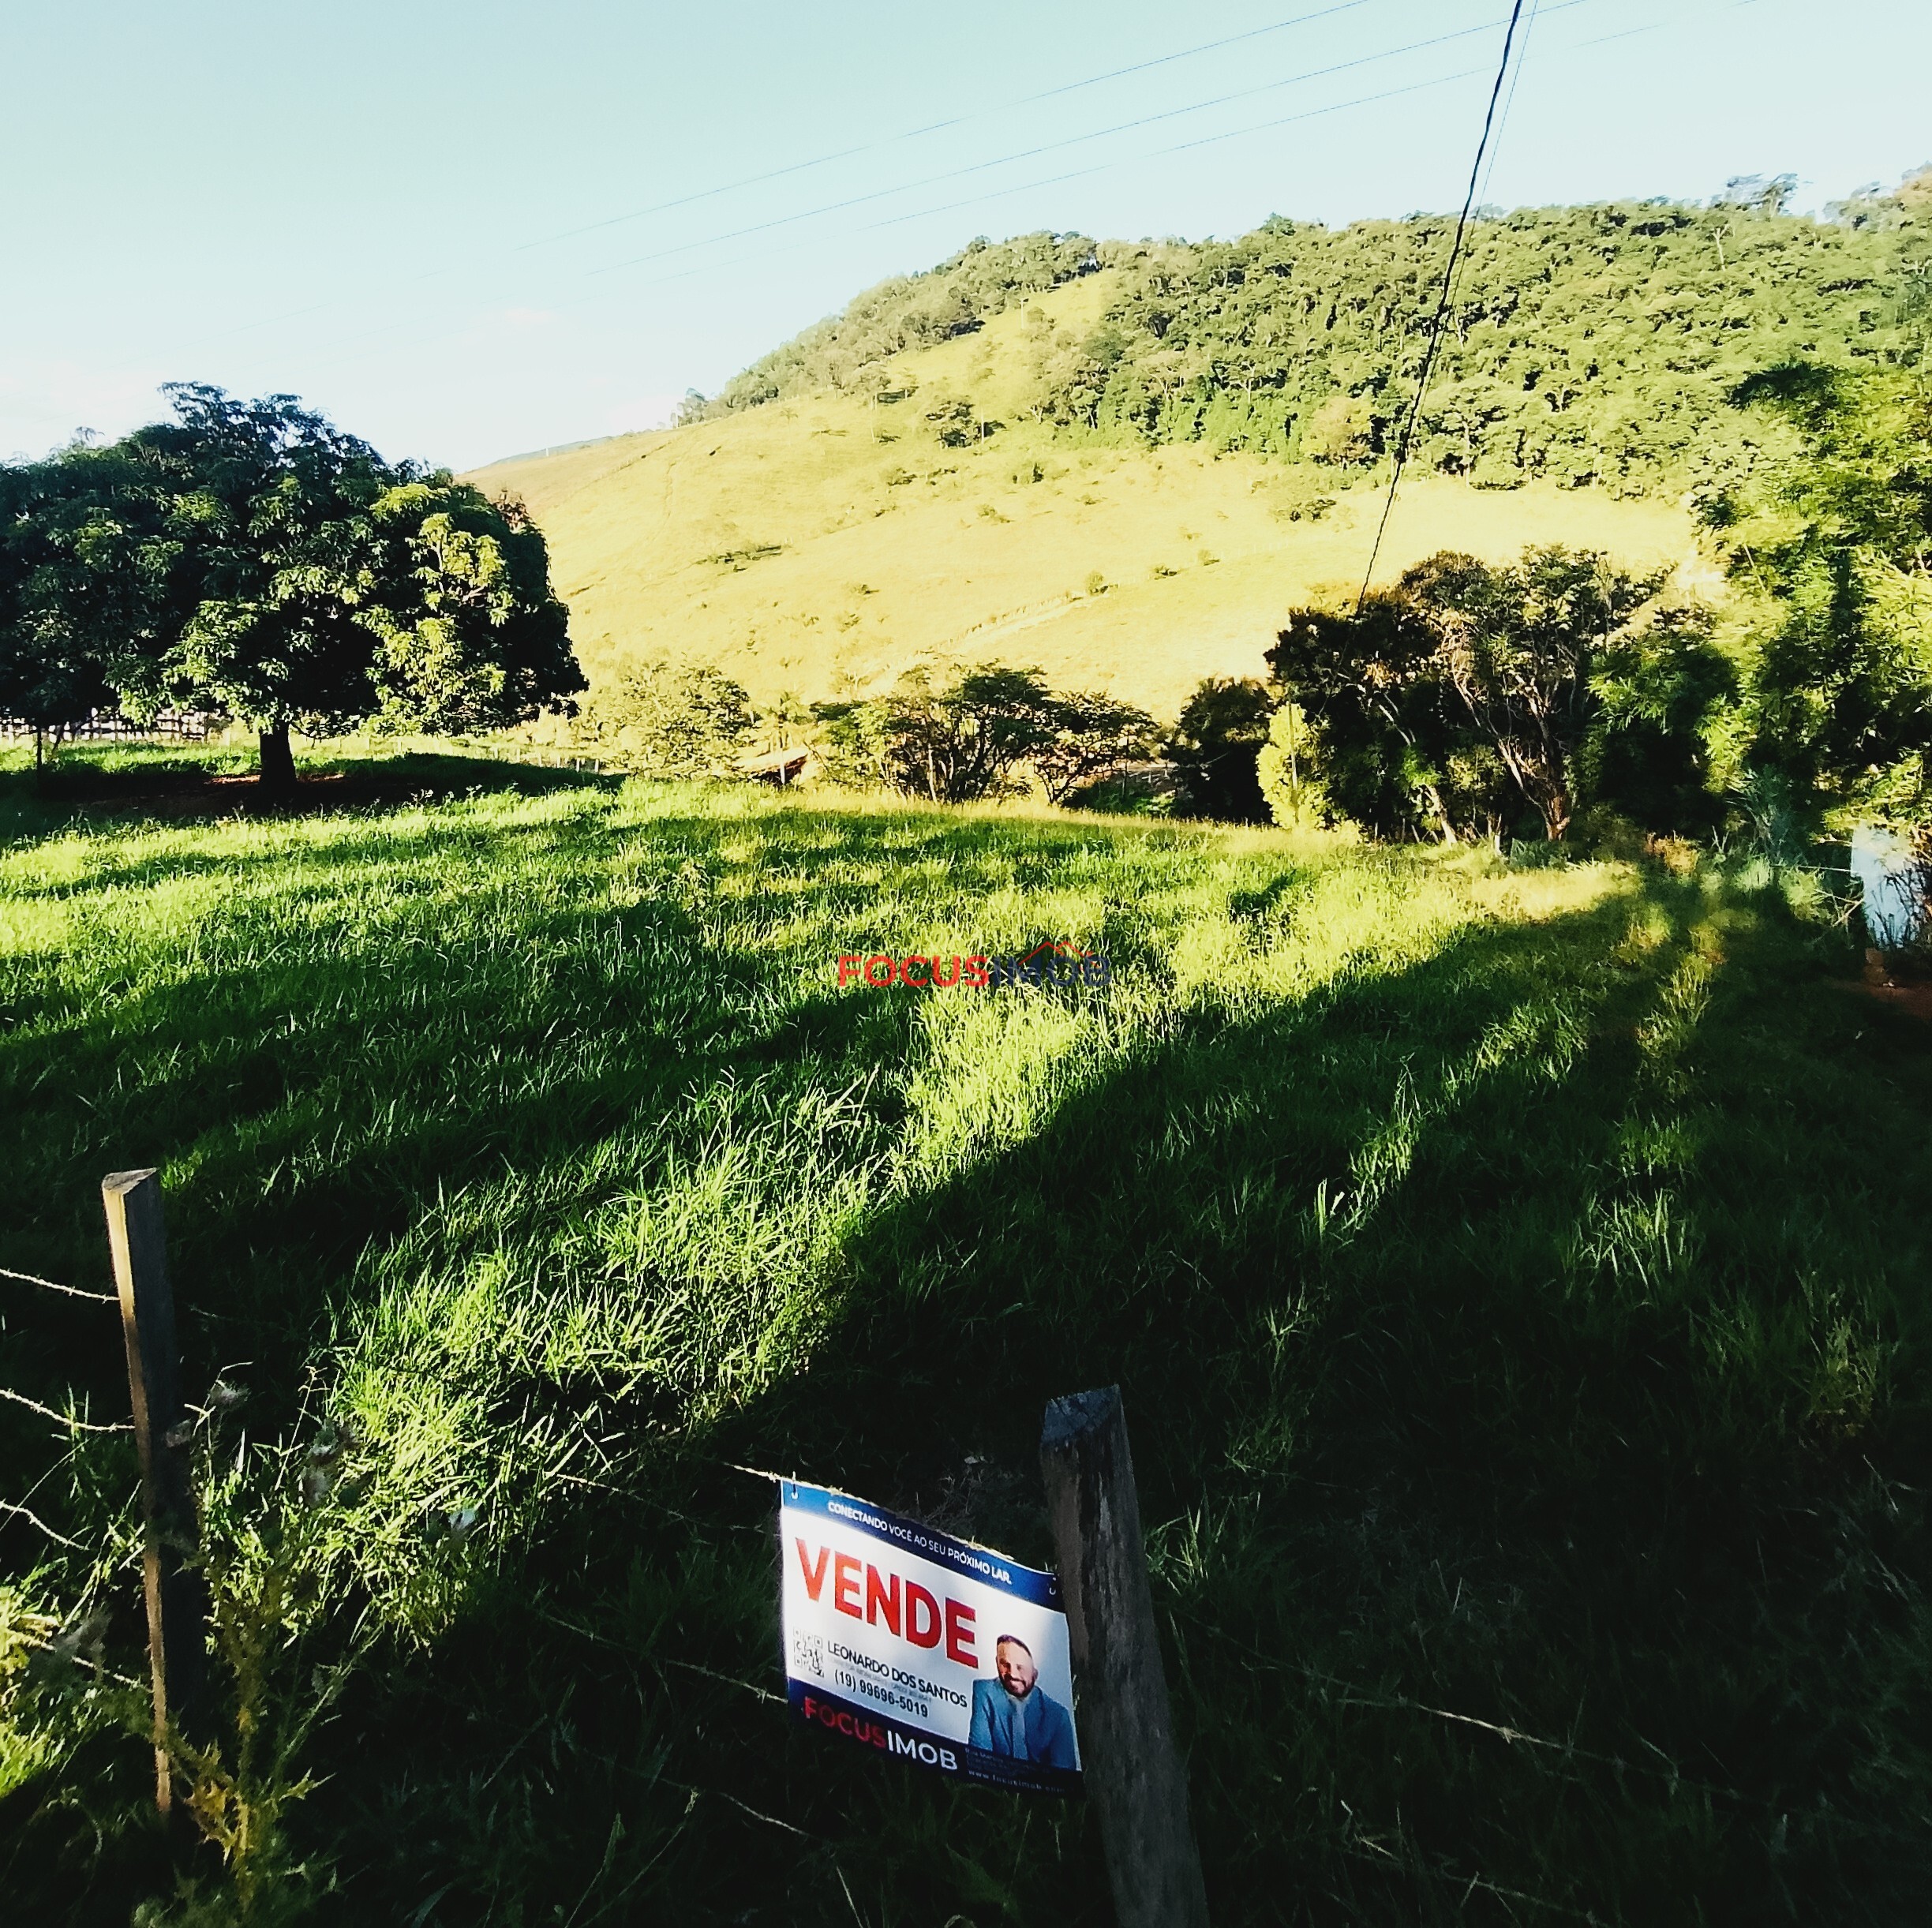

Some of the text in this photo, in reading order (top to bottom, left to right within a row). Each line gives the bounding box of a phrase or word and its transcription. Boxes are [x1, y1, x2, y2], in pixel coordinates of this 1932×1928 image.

[828, 1501, 888, 1531] CONECTANDO
[889, 1525, 912, 1542] VOCÊ
[914, 1534, 927, 1548] AO
[928, 1541, 946, 1556] SEU
[948, 1548, 990, 1574] PRÓXIMO
[795, 1537, 979, 1670] VENDE
[828, 1640, 889, 1677] LEONARDO
[892, 1667, 916, 1689] DOS
[918, 1679, 968, 1708] SANTOS
[834, 1668, 856, 1693] (19)
[859, 1679, 928, 1718] 99696-5019
